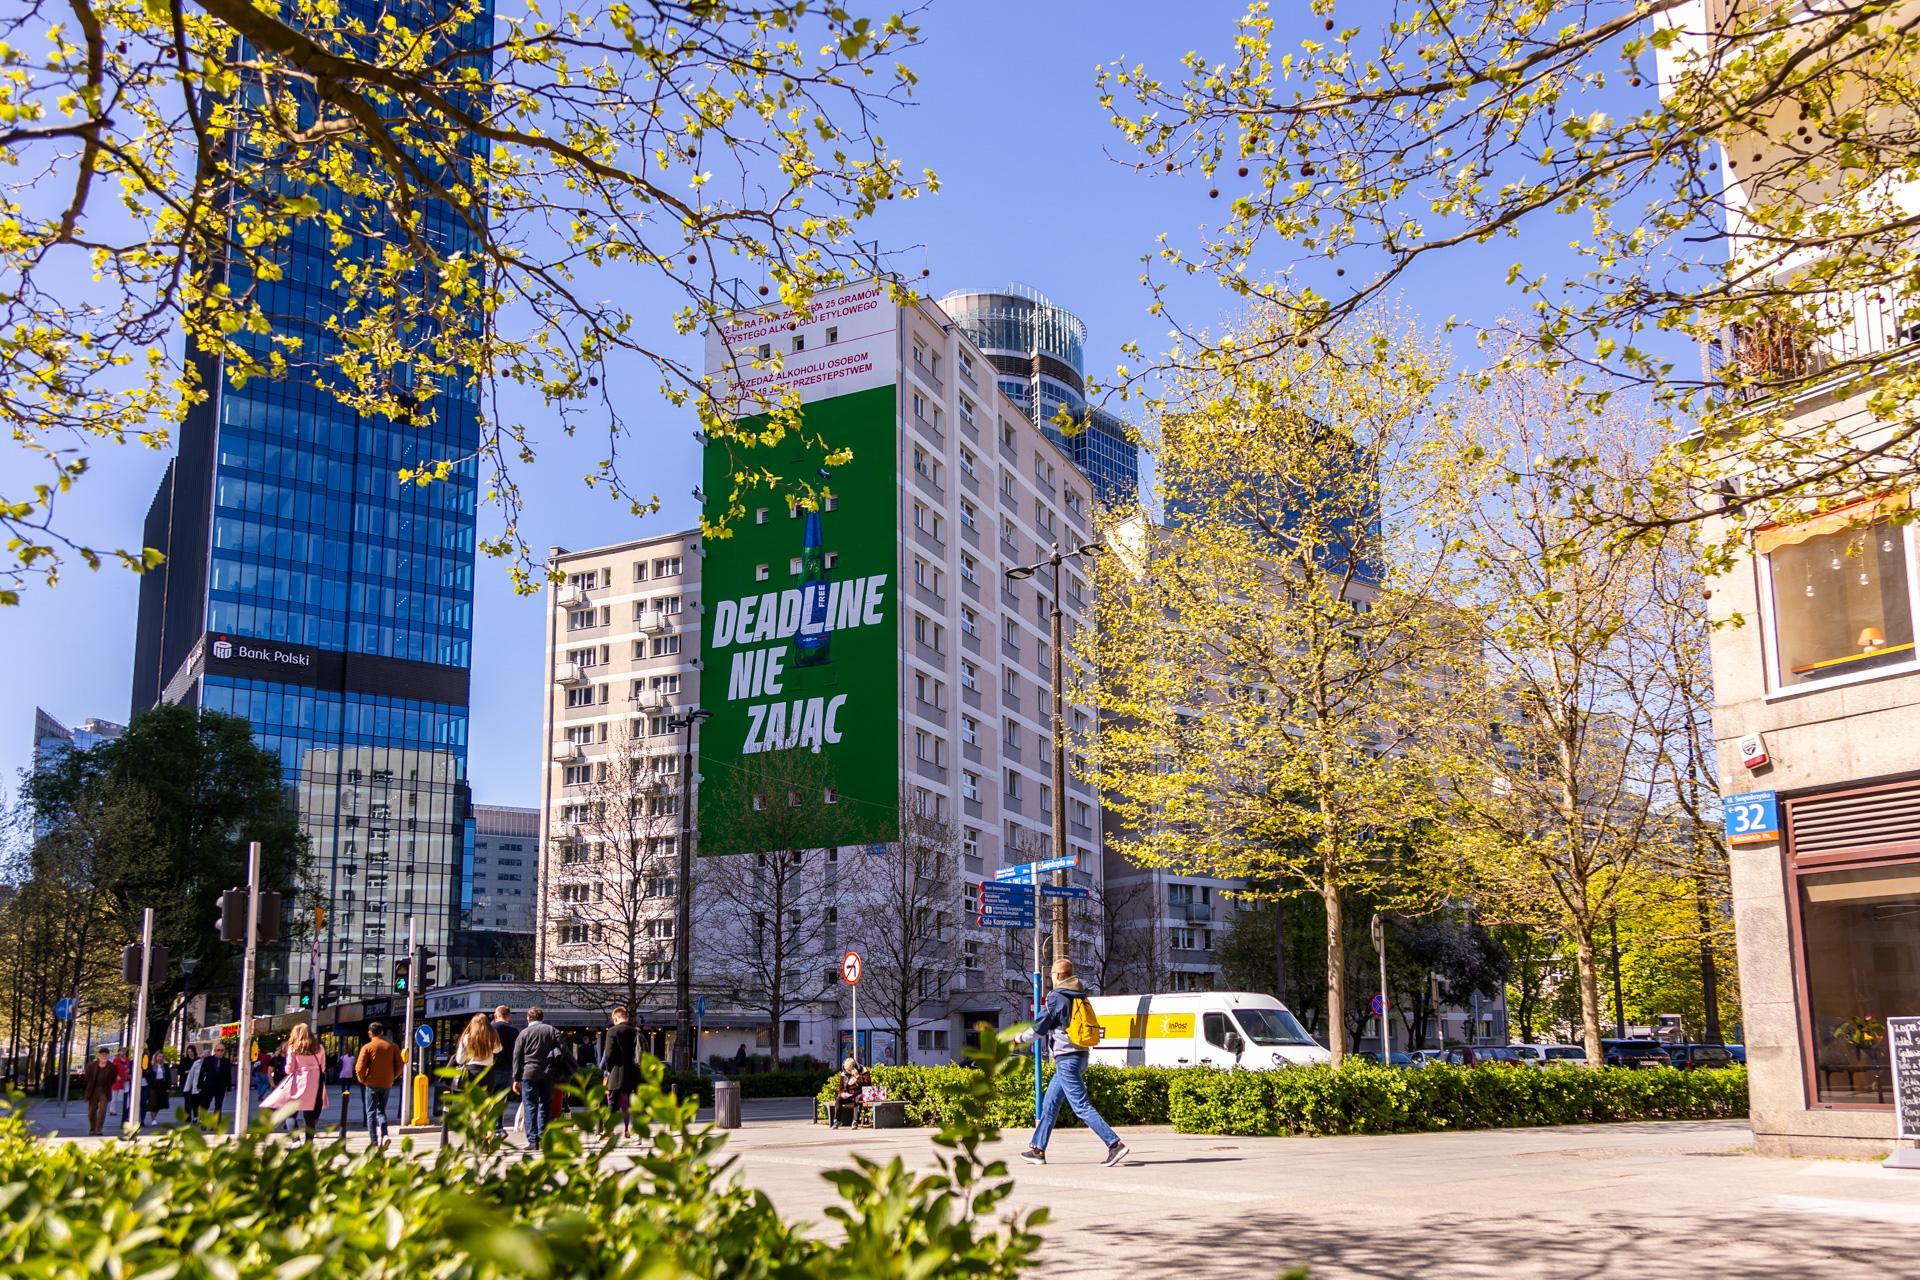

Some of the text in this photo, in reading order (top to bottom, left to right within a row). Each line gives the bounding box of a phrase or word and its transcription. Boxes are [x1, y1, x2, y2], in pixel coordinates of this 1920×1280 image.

[820, 300, 878, 322] ETYLOWEGO
[825, 299, 836, 309] 25
[776, 362, 825, 380] ALKOHOLU
[827, 352, 869, 368] OSOBOM
[818, 584, 826, 608] FREE
[712, 574, 888, 648] DEADLINE
[239, 646, 310, 666] Bank Polski
[727, 646, 788, 701] NIE
[742, 694, 848, 754] ZAJĄC
[1734, 803, 1767, 832] 32
